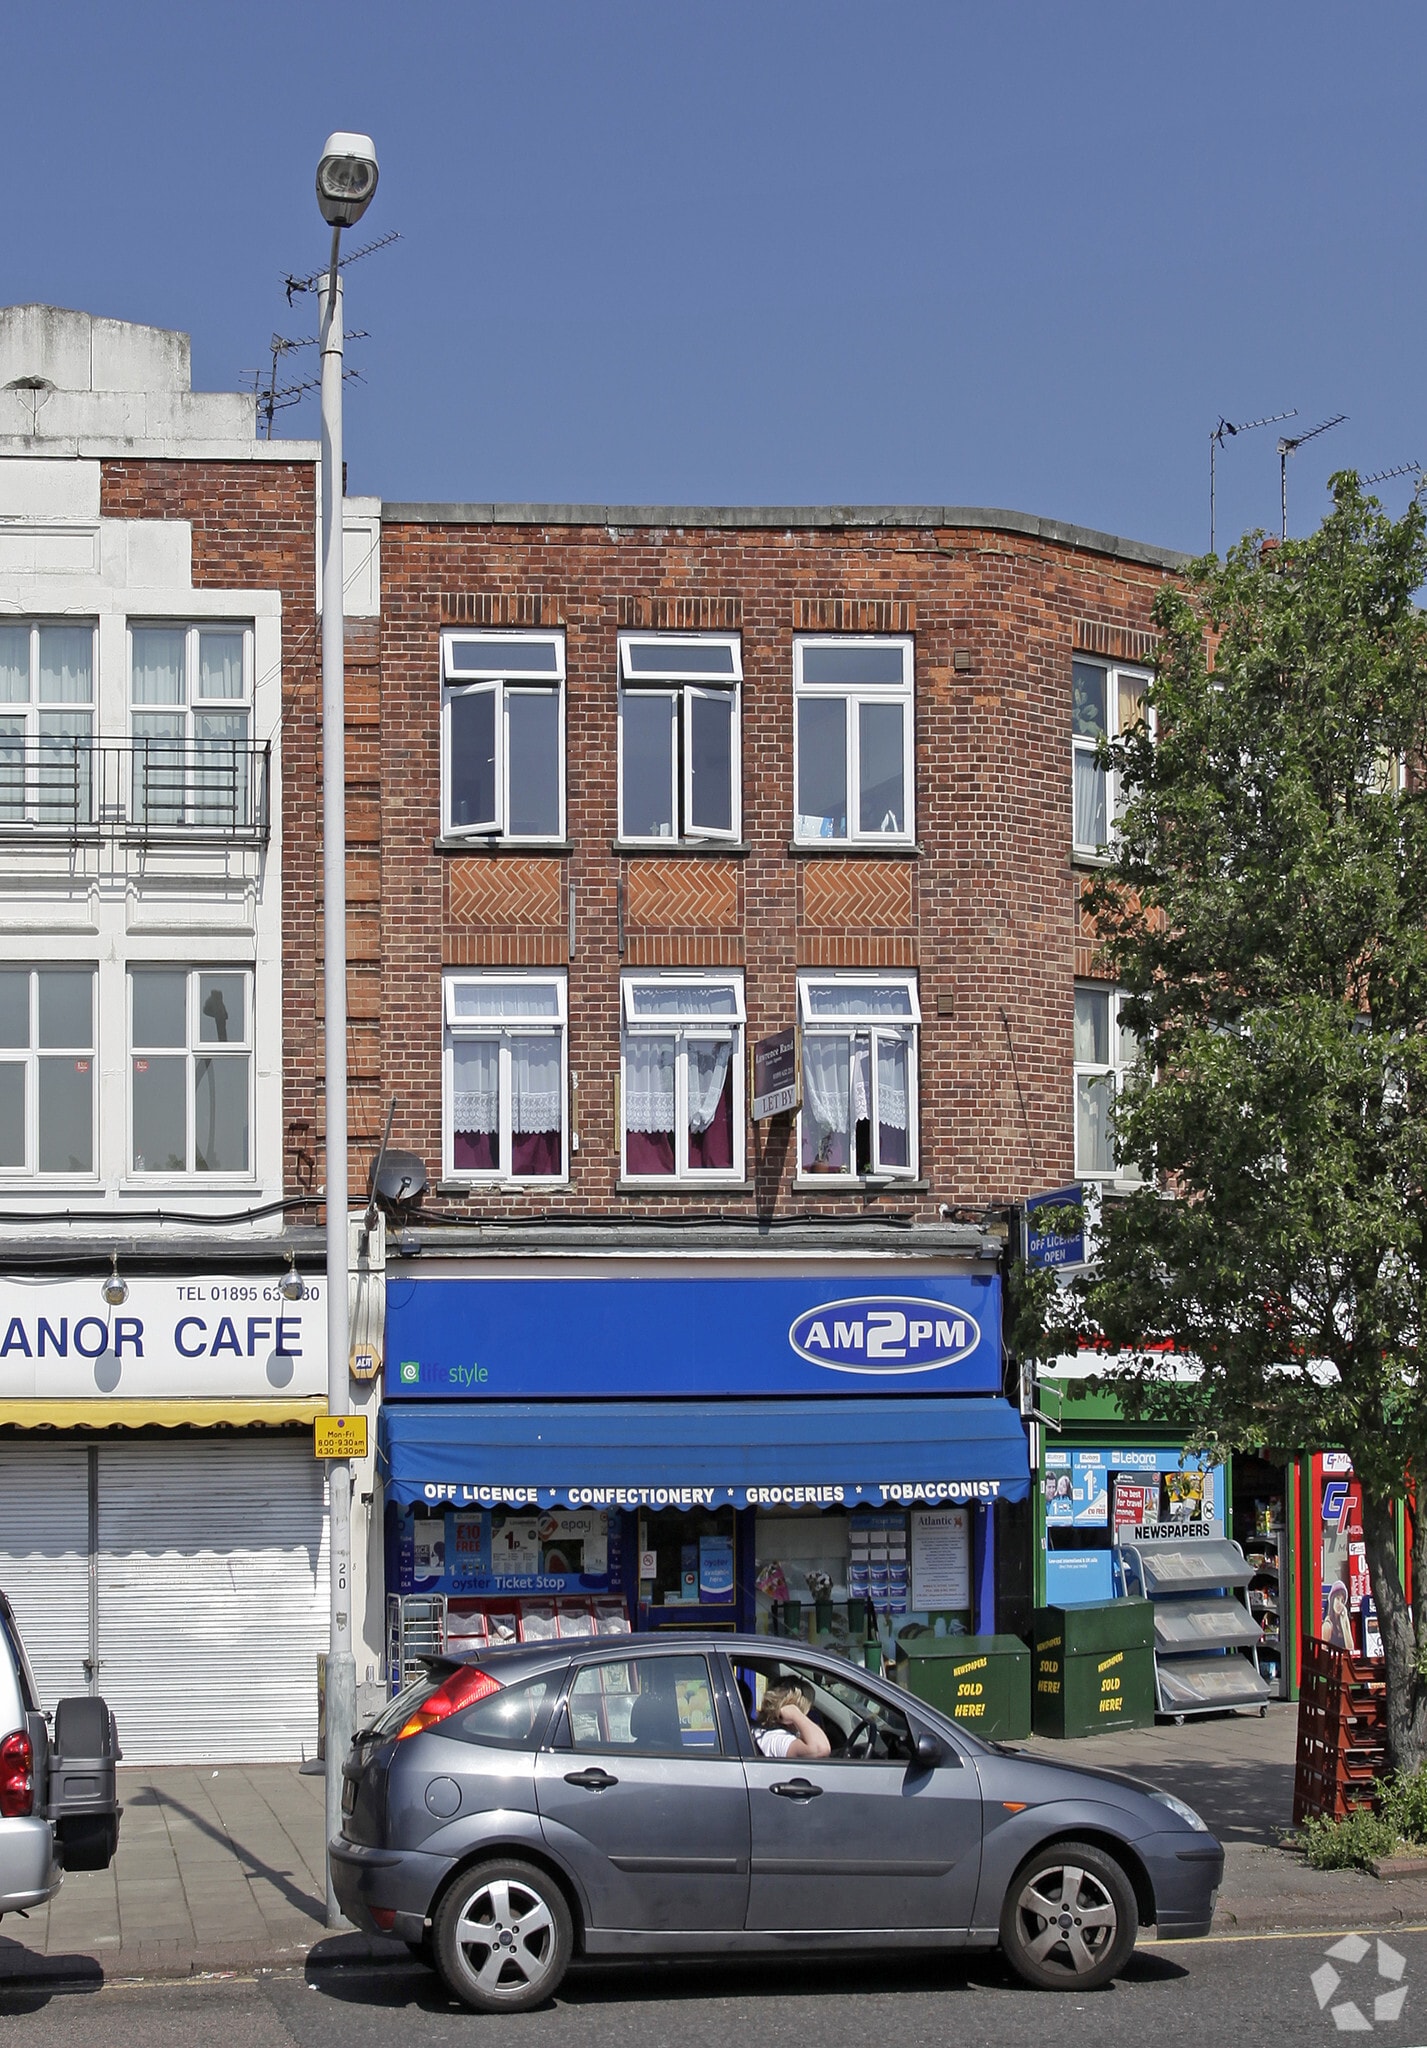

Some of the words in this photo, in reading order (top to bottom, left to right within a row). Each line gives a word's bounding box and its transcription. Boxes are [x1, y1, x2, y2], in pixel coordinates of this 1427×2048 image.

[762, 1093, 779, 1113] LET
[781, 1089, 794, 1107] BY
[1030, 1238, 1045, 1251] OFF
[1044, 1249, 1066, 1262] OPEN
[176, 1286, 206, 1301] TEL
[210, 1286, 258, 1301] 01895
[262, 1286, 320, 1301] 6380
[0, 1317, 144, 1358] ANOR
[174, 1316, 303, 1357] CAFE
[804, 1311, 966, 1358] AM2PM
[356, 1358, 372, 1368] ADT
[1120, 1452, 1156, 1464] Lebara
[424, 1484, 457, 1499] OFF
[462, 1485, 538, 1502] LICENCE
[568, 1488, 715, 1504] CONFECTIONERY
[746, 1486, 845, 1502] GROCERIES
[879, 1481, 1001, 1500] TOBACCONIST
[1117, 1488, 1128, 1497] The
[561, 1520, 591, 1532] epay
[918, 1515, 952, 1526] Atlantic
[456, 1525, 481, 1540] £10
[1134, 1523, 1210, 1540] NEWSPAPERS
[456, 1541, 481, 1553] FREE
[452, 1578, 490, 1593] oyster
[494, 1576, 533, 1589] Ticket
[535, 1576, 566, 1591] Stop
[953, 1657, 988, 1677] NEWSPAPERS
[1040, 1660, 1059, 1673] SOLD
[1097, 1652, 1124, 1673] NEWSPAPERS
[957, 1683, 983, 1697] SOLD
[1037, 1680, 1061, 1693] HERE!
[1101, 1677, 1121, 1692] SOLD
[954, 1703, 986, 1718] HERE!
[1099, 1697, 1122, 1713] HERE!
